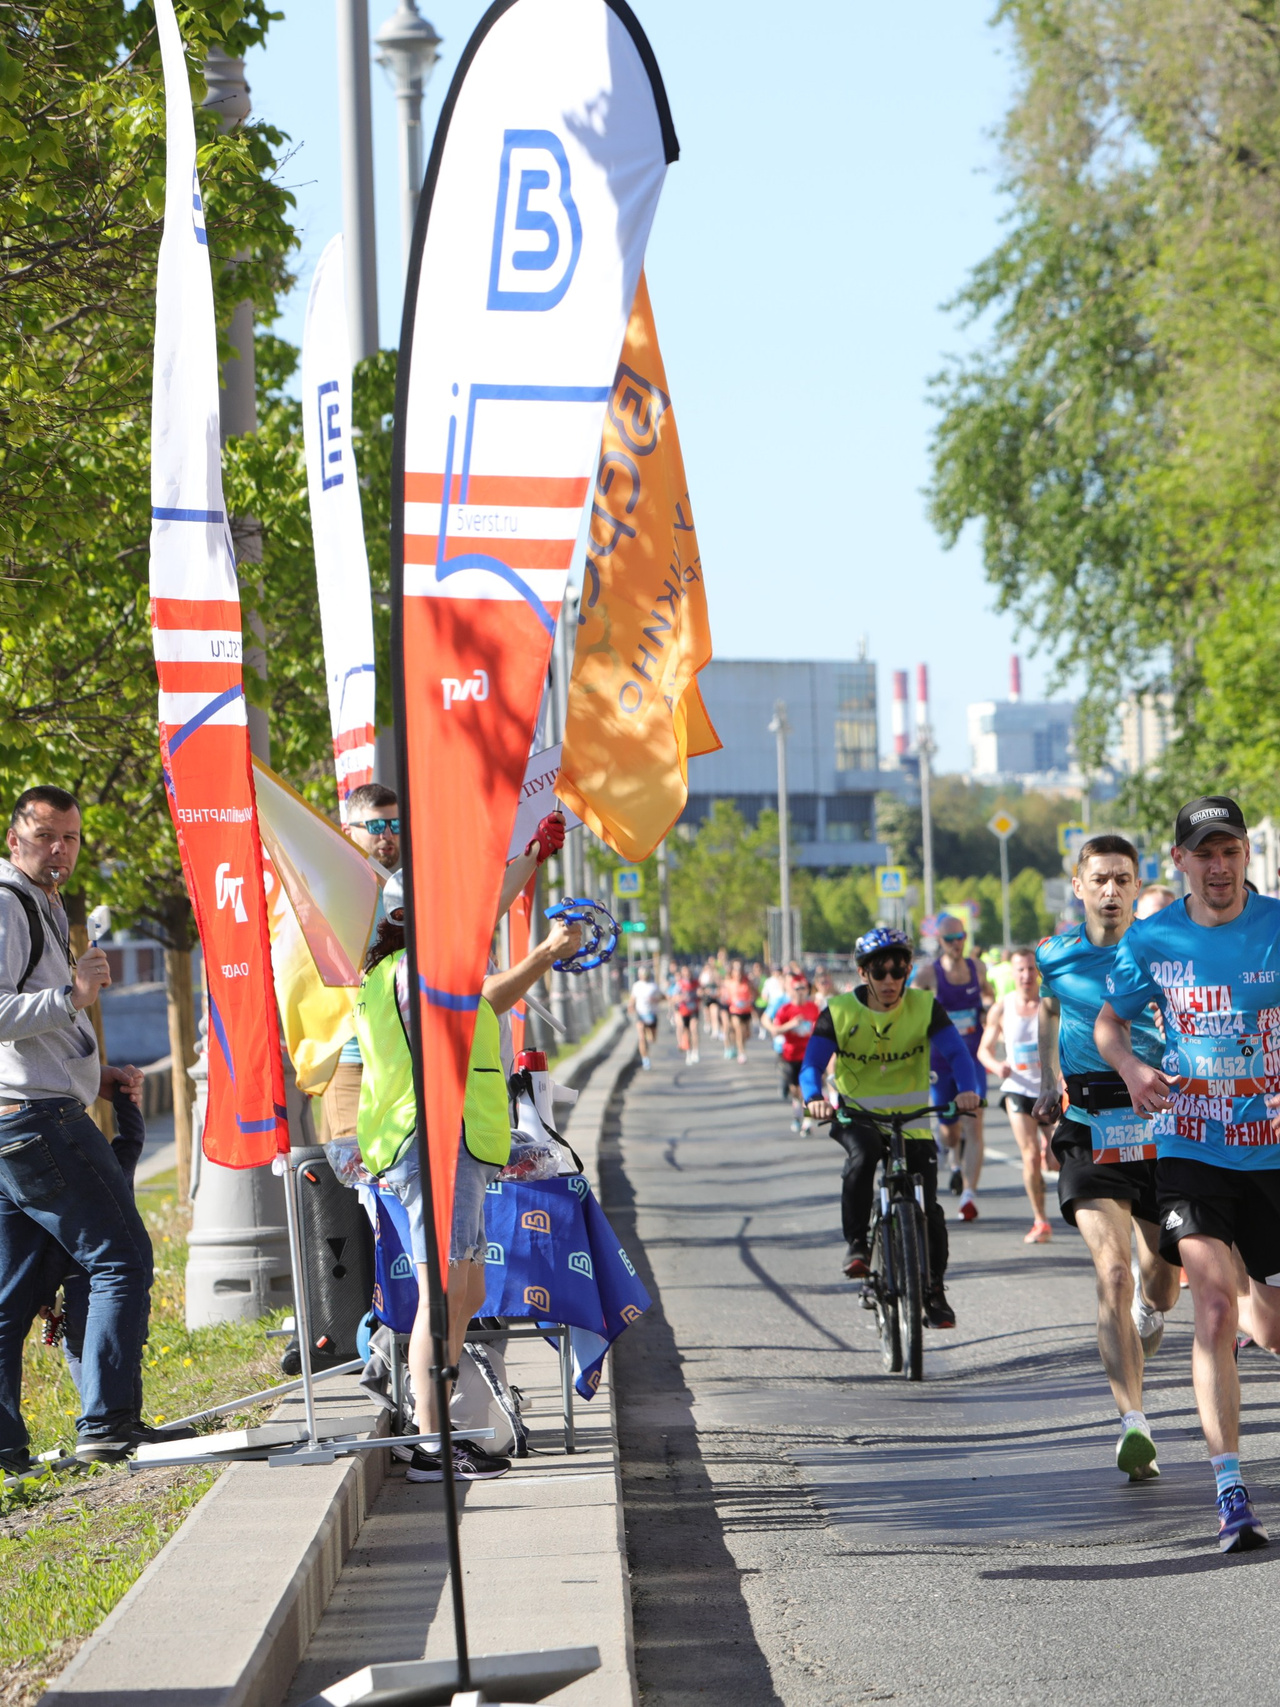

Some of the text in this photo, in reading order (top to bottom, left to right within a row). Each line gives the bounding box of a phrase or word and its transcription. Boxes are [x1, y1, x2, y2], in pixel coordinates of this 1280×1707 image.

[456, 508, 518, 532] 5verst.ru
[1151, 960, 1195, 987] 2024
[1195, 1056, 1246, 1077] 21452
[1106, 1123, 1153, 1146] 25254
